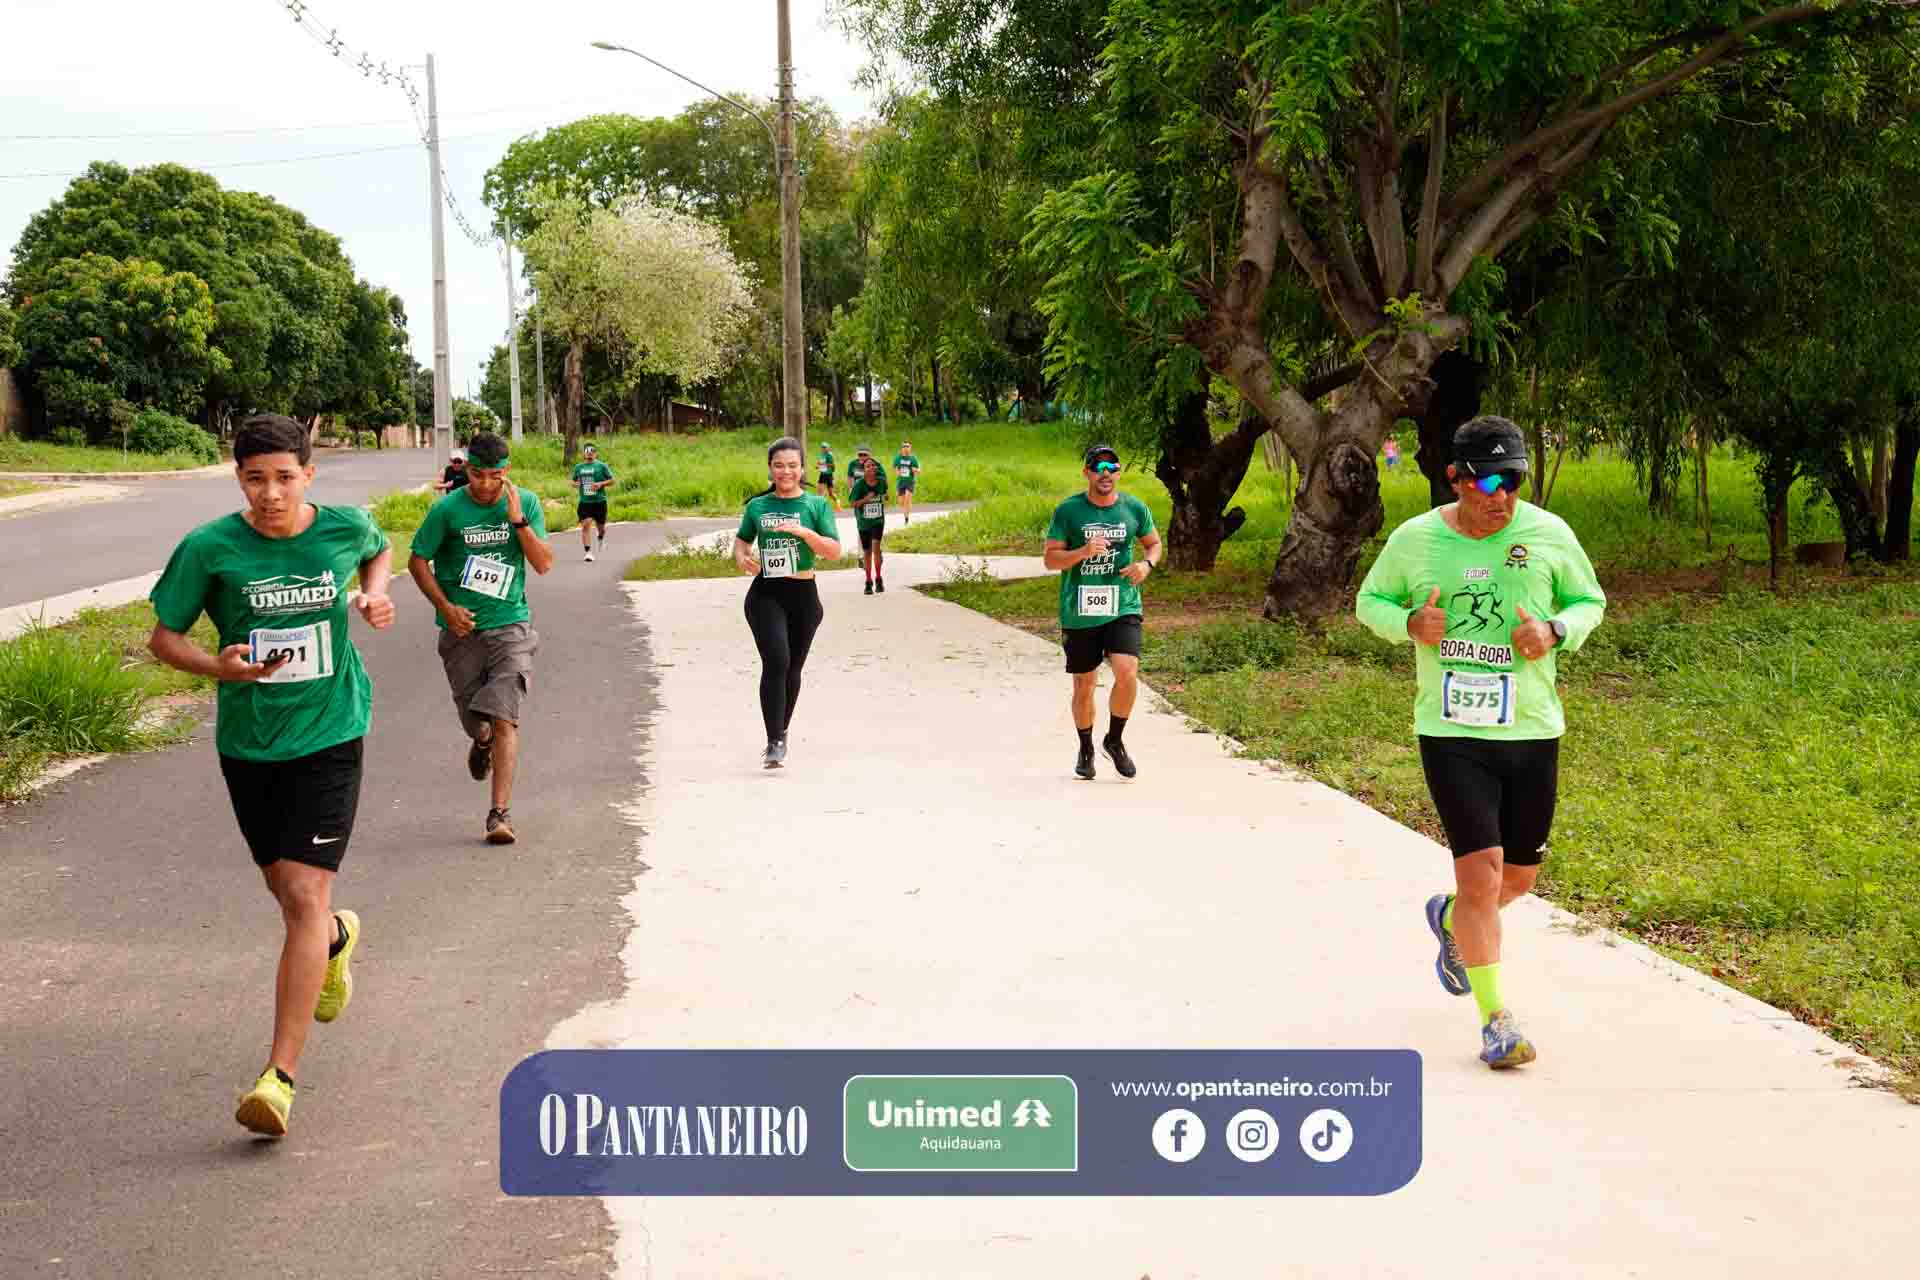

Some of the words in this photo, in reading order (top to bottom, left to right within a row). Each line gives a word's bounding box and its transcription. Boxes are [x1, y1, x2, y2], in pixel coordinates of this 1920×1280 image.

[464, 530, 510, 544] UNIMED
[768, 558, 786, 568] 607
[474, 569, 498, 584] 619
[249, 586, 337, 609] UNIMED
[1087, 595, 1108, 606] 508
[1440, 639, 1475, 659] BORA
[1479, 644, 1512, 664] BORA
[1450, 689, 1500, 709] 3575
